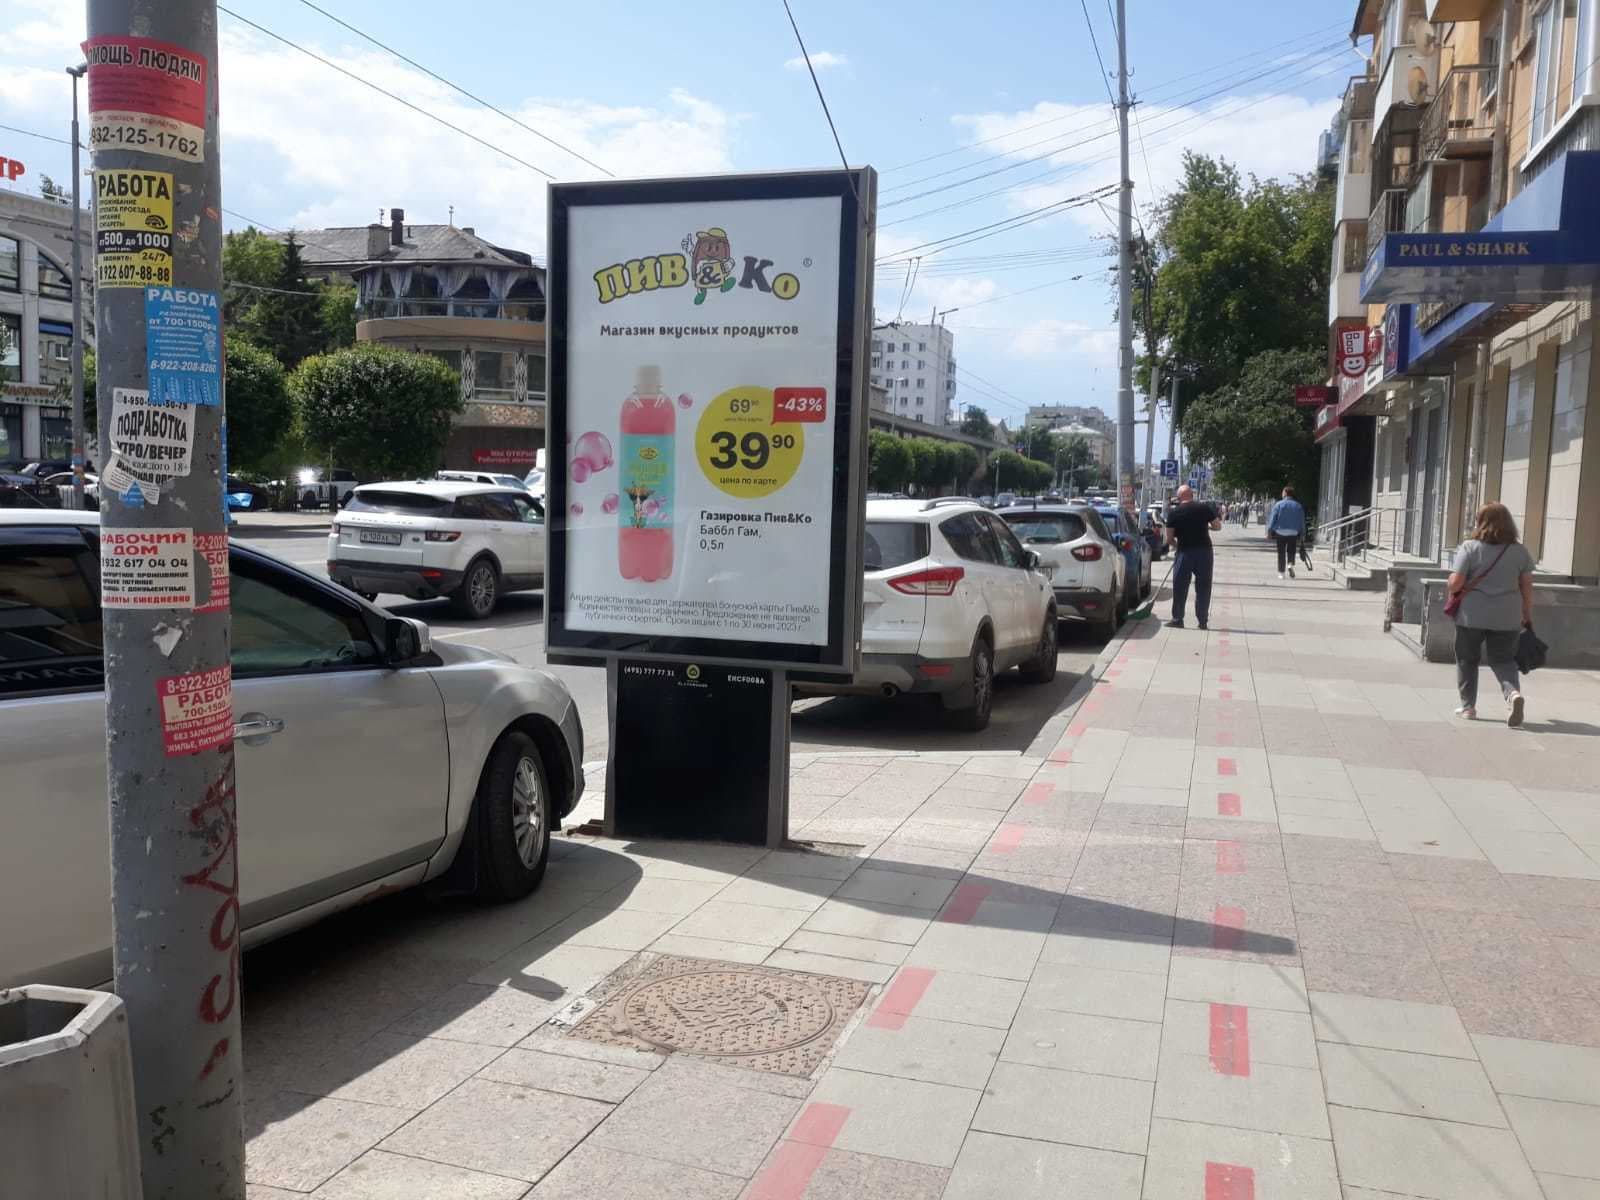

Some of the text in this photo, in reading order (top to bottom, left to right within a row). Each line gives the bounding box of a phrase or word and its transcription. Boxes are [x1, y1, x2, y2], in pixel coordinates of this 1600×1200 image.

[138, 48, 201, 82] ЛЮДЯМ
[98, 173, 170, 200] РАБОТА
[105, 232, 123, 246] 500
[136, 232, 169, 248] 1000
[1400, 241, 1529, 257] PAUL & SHARK
[142, 252, 166, 262] 24/7
[119, 263, 170, 282] 607-88-88
[148, 288, 217, 308] РАБОТА
[600, 325, 799, 338] Магазин вкусных продуктов
[730, 399, 751, 413] 69
[777, 398, 824, 412] -43%
[117, 410, 188, 442] ПОДРАБОТКА
[709, 430, 795, 470] 39 90
[720, 478, 740, 487] цена
[753, 478, 778, 488] карте
[700, 510, 812, 524] Газировка Пив&Ко
[101, 532, 187, 544] РАБОЧИЙ
[700, 525, 762, 539] Баббл Гам,
[112, 545, 159, 556] ДОМ
[700, 539, 724, 551] 0,5л
[123, 558, 144, 568] 617
[148, 558, 166, 568] 04
[170, 558, 189, 568] 04
